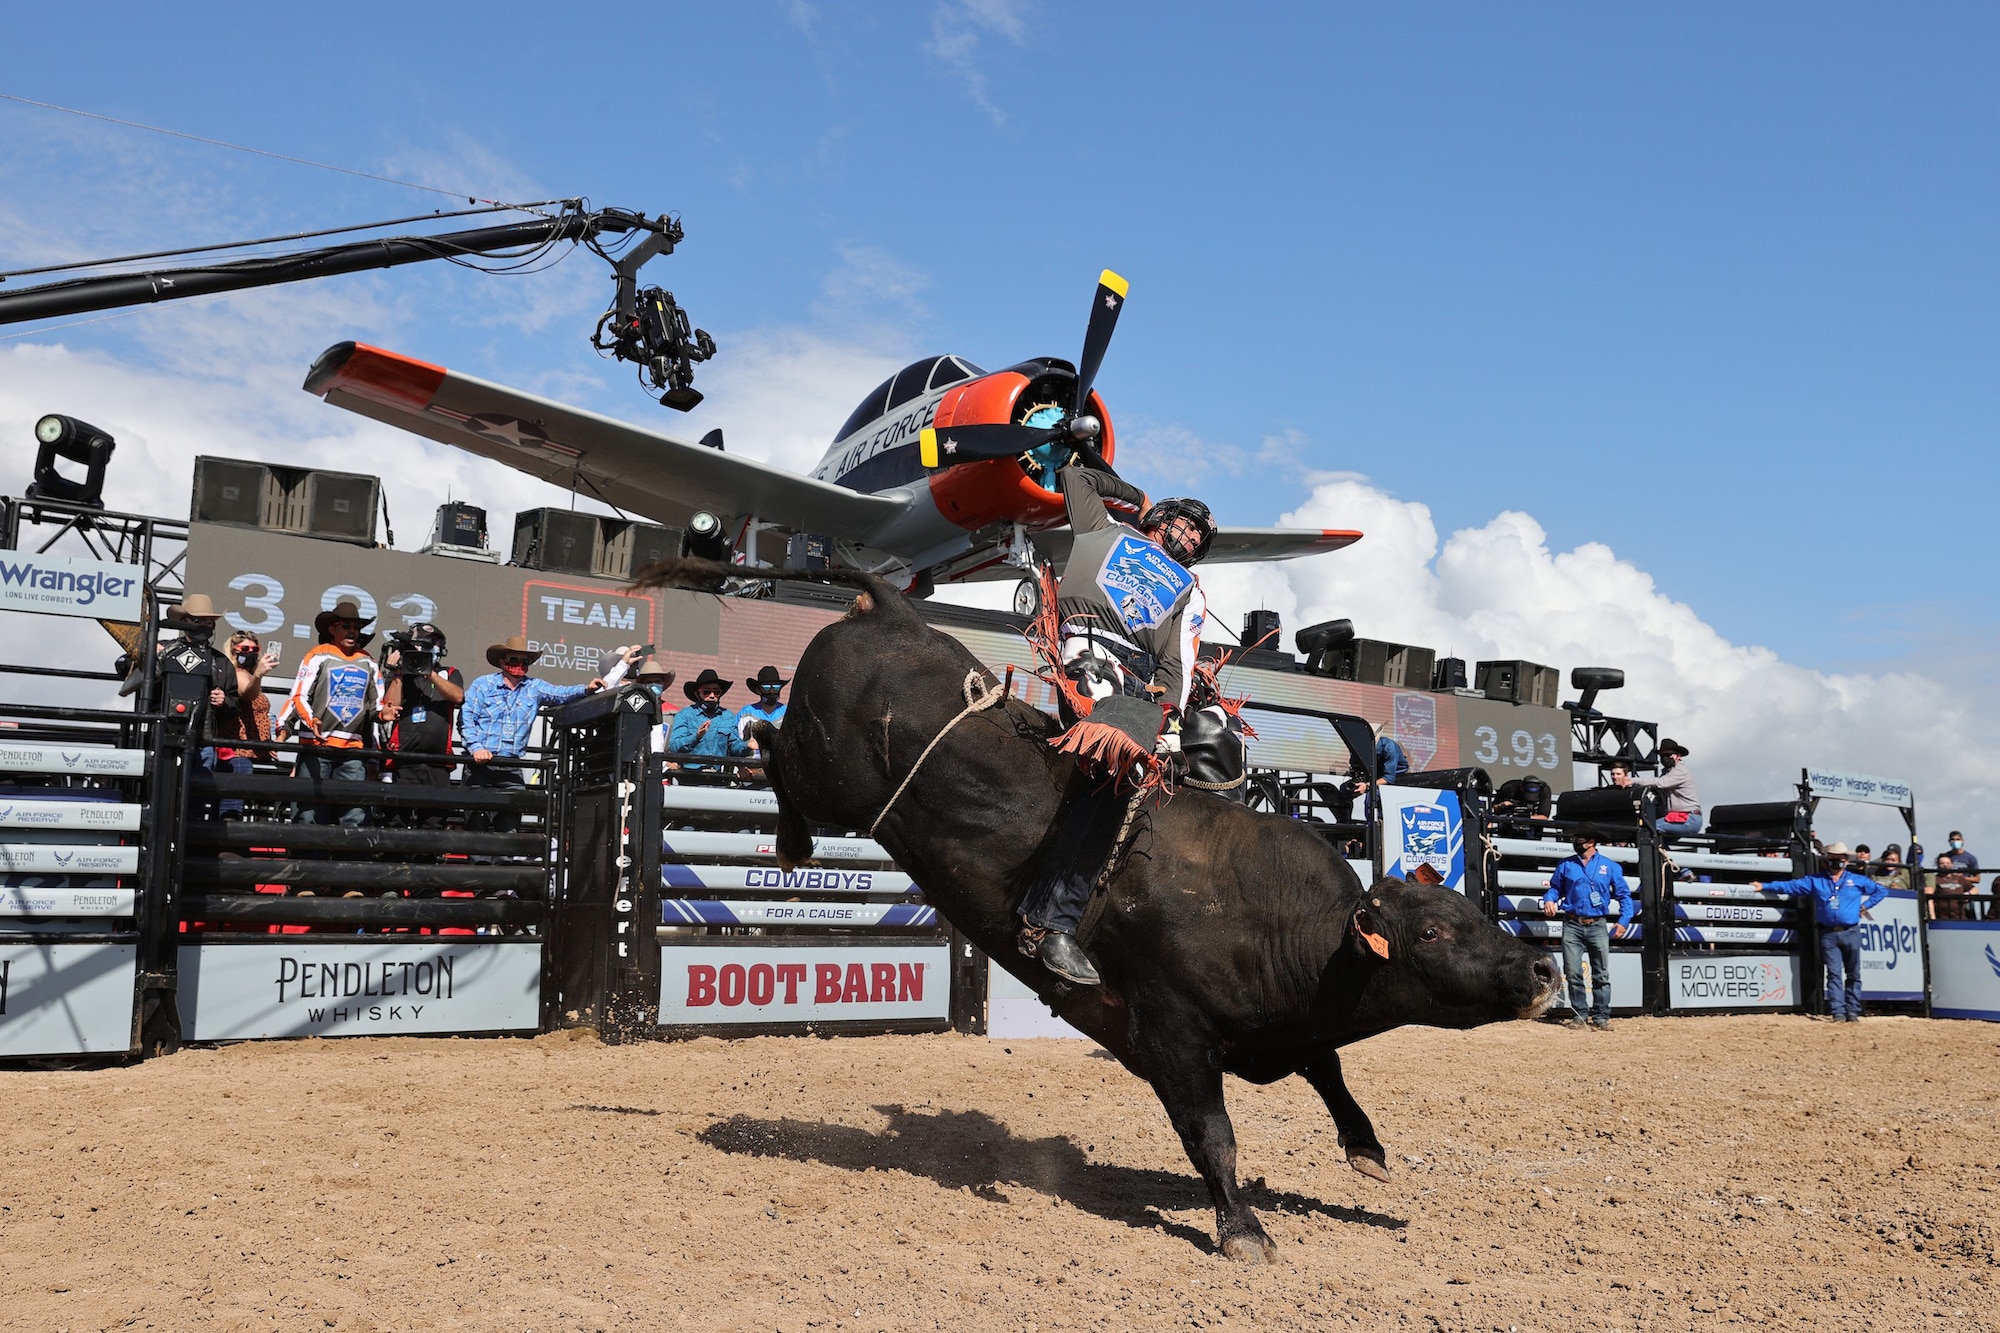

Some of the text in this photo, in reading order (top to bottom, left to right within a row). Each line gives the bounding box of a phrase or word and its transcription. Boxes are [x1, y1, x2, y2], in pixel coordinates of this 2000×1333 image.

[835, 398, 941, 479] AIR FORCE
[0, 560, 135, 605] Wrangler
[5, 591, 73, 604] LONG LIVE COWBOYS
[541, 595, 636, 631] TEAM
[527, 640, 567, 656] BAD
[533, 654, 600, 673] OWER
[0, 750, 43, 763] PENDLETON
[1474, 725, 1559, 770] 3.93
[1810, 772, 1842, 792] Wrangler
[1845, 776, 1877, 797] Wrangler
[1879, 781, 1909, 801] Wrangler
[80, 808, 124, 821] PENDLETON
[0, 851, 35, 863] NDLETON
[757, 845, 776, 853] PB
[1406, 854, 1447, 865] COWBOYS
[746, 869, 873, 890] COWBOYS
[73, 894, 118, 906] PENDLETON
[766, 908, 854, 919] FOR A CAUSE
[1706, 907, 1763, 920] COWBOYS
[1860, 918, 1917, 970] angler
[275, 956, 455, 1003] PENDLETON
[1682, 966, 1757, 979] BAD BOY
[686, 963, 925, 1007] BOOT BARN
[1682, 982, 1760, 997] MOWERS
[308, 1004, 424, 1023] WHISKY
